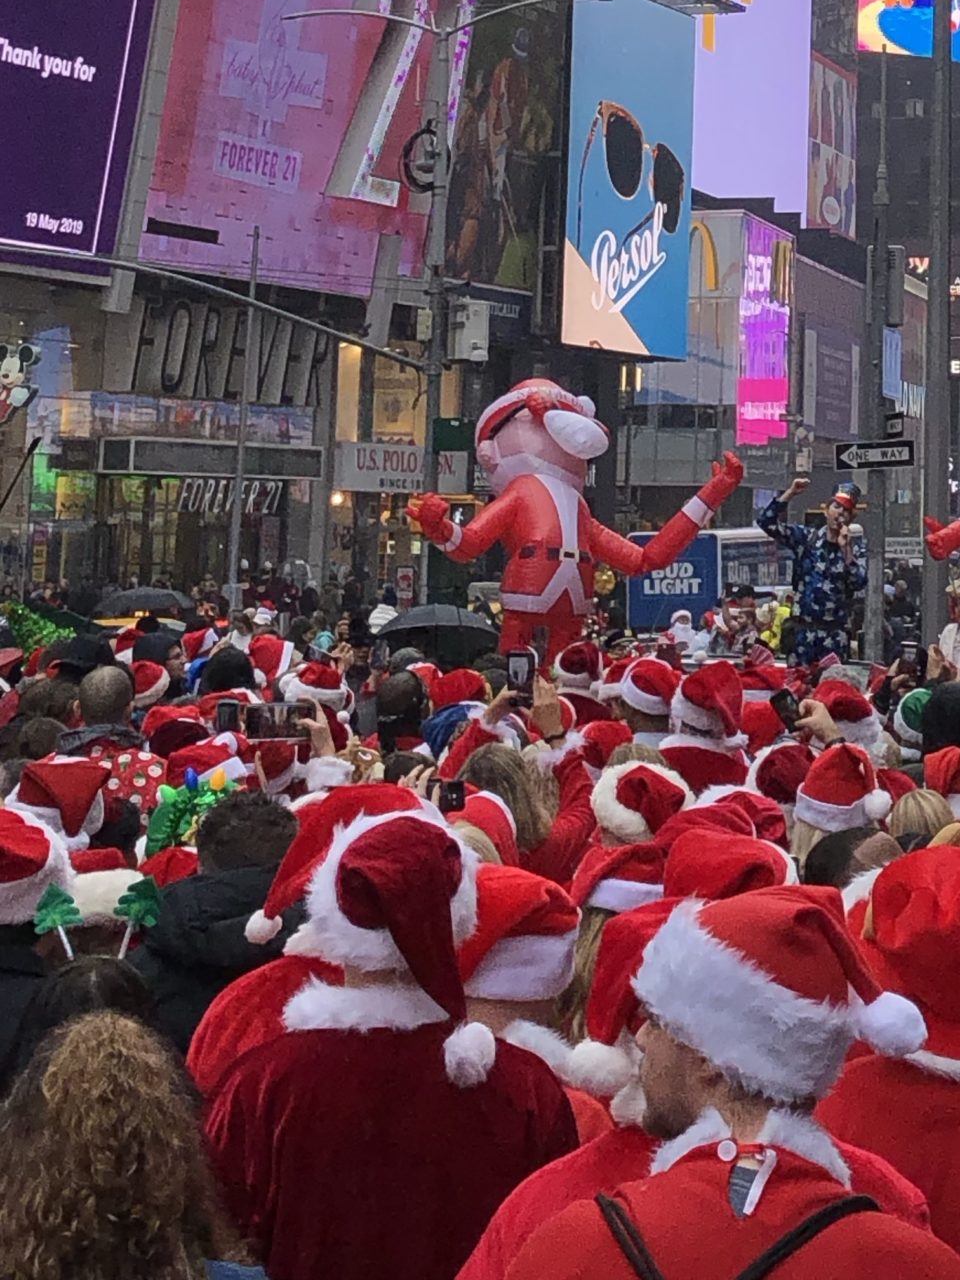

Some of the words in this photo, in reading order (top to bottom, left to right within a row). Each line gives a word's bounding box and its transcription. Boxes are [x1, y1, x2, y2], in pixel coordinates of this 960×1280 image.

[42, 56, 71, 79] you
[73, 55, 96, 83] for
[220, 140, 279, 179] FOREVER
[282, 154, 298, 183] 21
[25, 212, 37, 226] 19
[38, 215, 60, 235] May
[60, 218, 84, 235] 2019
[591, 200, 667, 311] Persol
[131, 295, 330, 406] FOREVER
[356, 448, 380, 470] U.S.
[383, 451, 418, 471] POLO
[847, 449, 869, 462] ONE
[880, 447, 904, 459] WAY
[177, 478, 260, 514] FOREVER
[261, 481, 283, 514] 21
[651, 562, 694, 579] BUD
[643, 578, 702, 595] LIGHT
